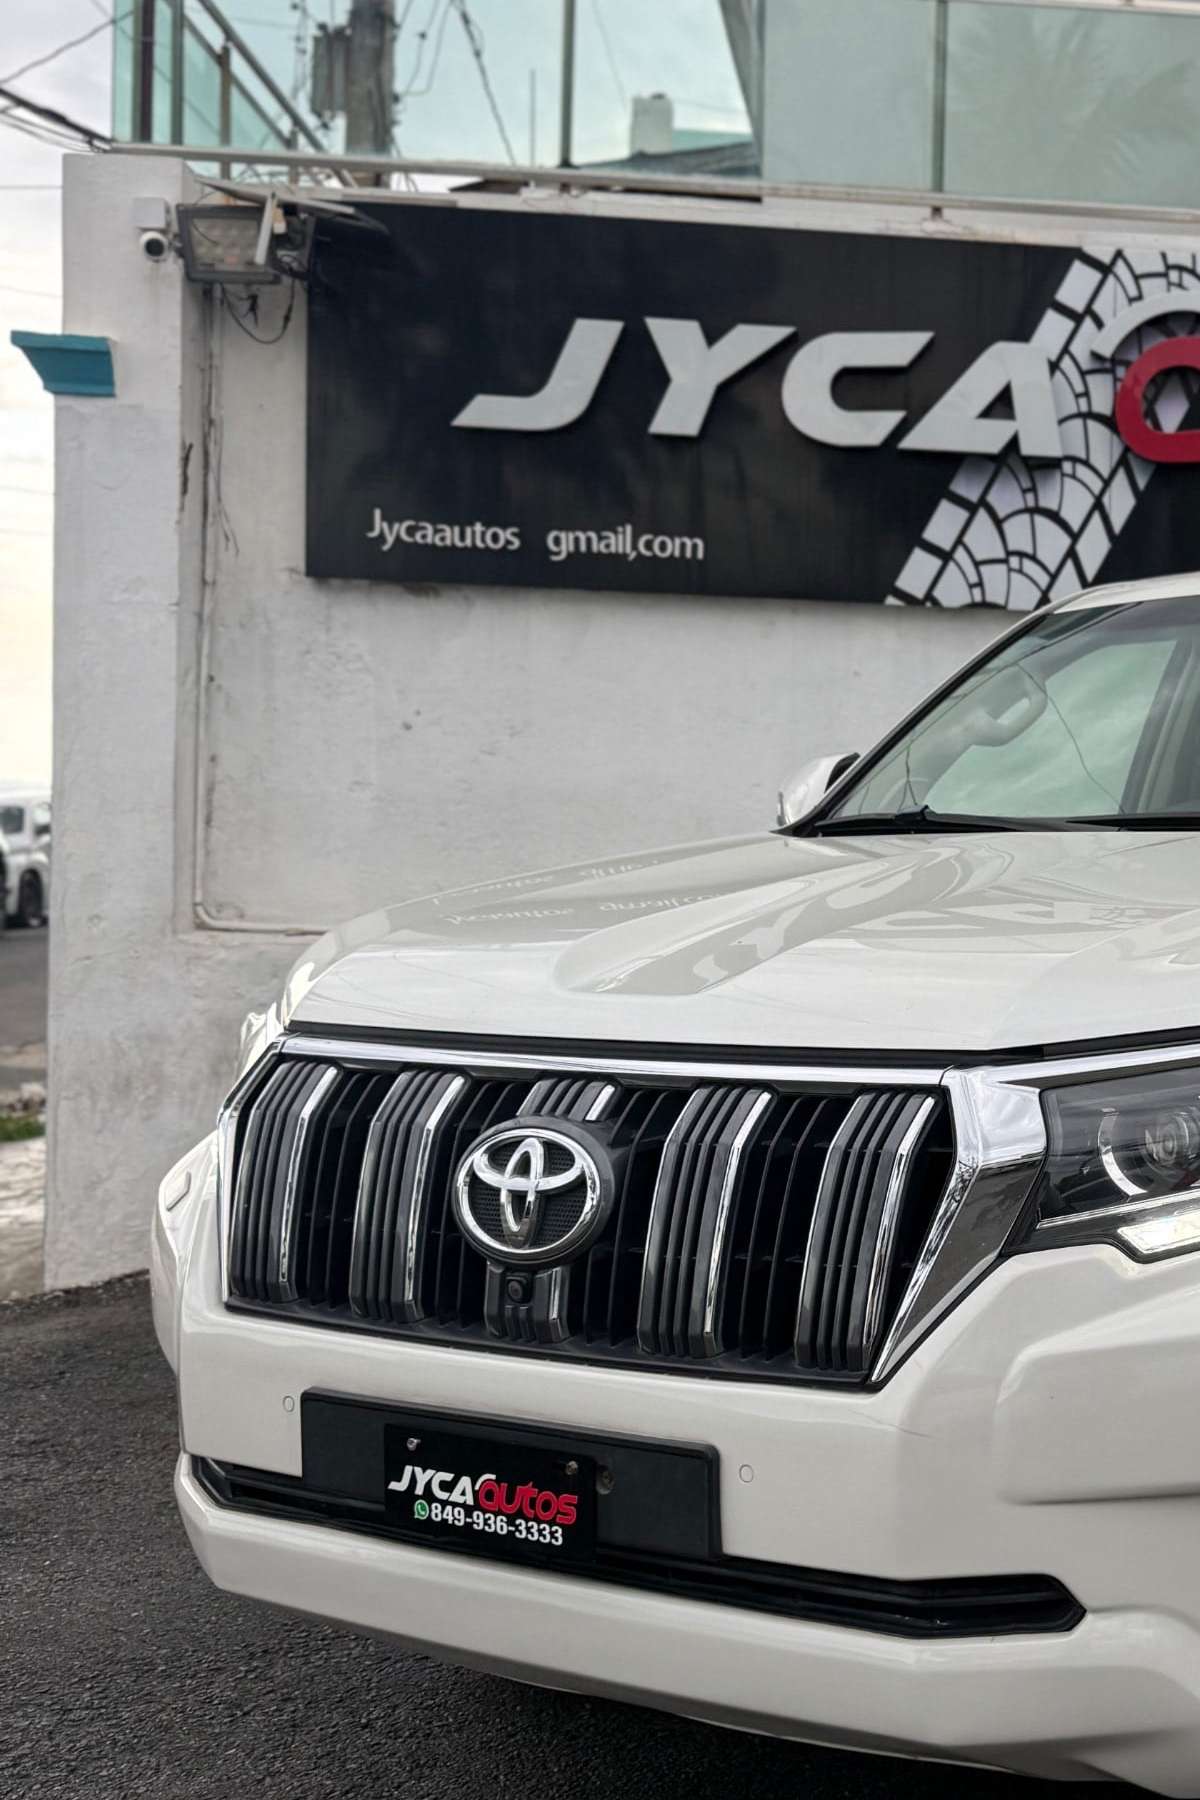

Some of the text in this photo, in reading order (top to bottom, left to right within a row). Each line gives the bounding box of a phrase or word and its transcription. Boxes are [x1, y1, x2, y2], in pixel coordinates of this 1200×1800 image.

[451, 316, 1064, 459] JYCA
[366, 507, 521, 552] Jycaautos
[431, 1502, 563, 1546] 849-936-3333
